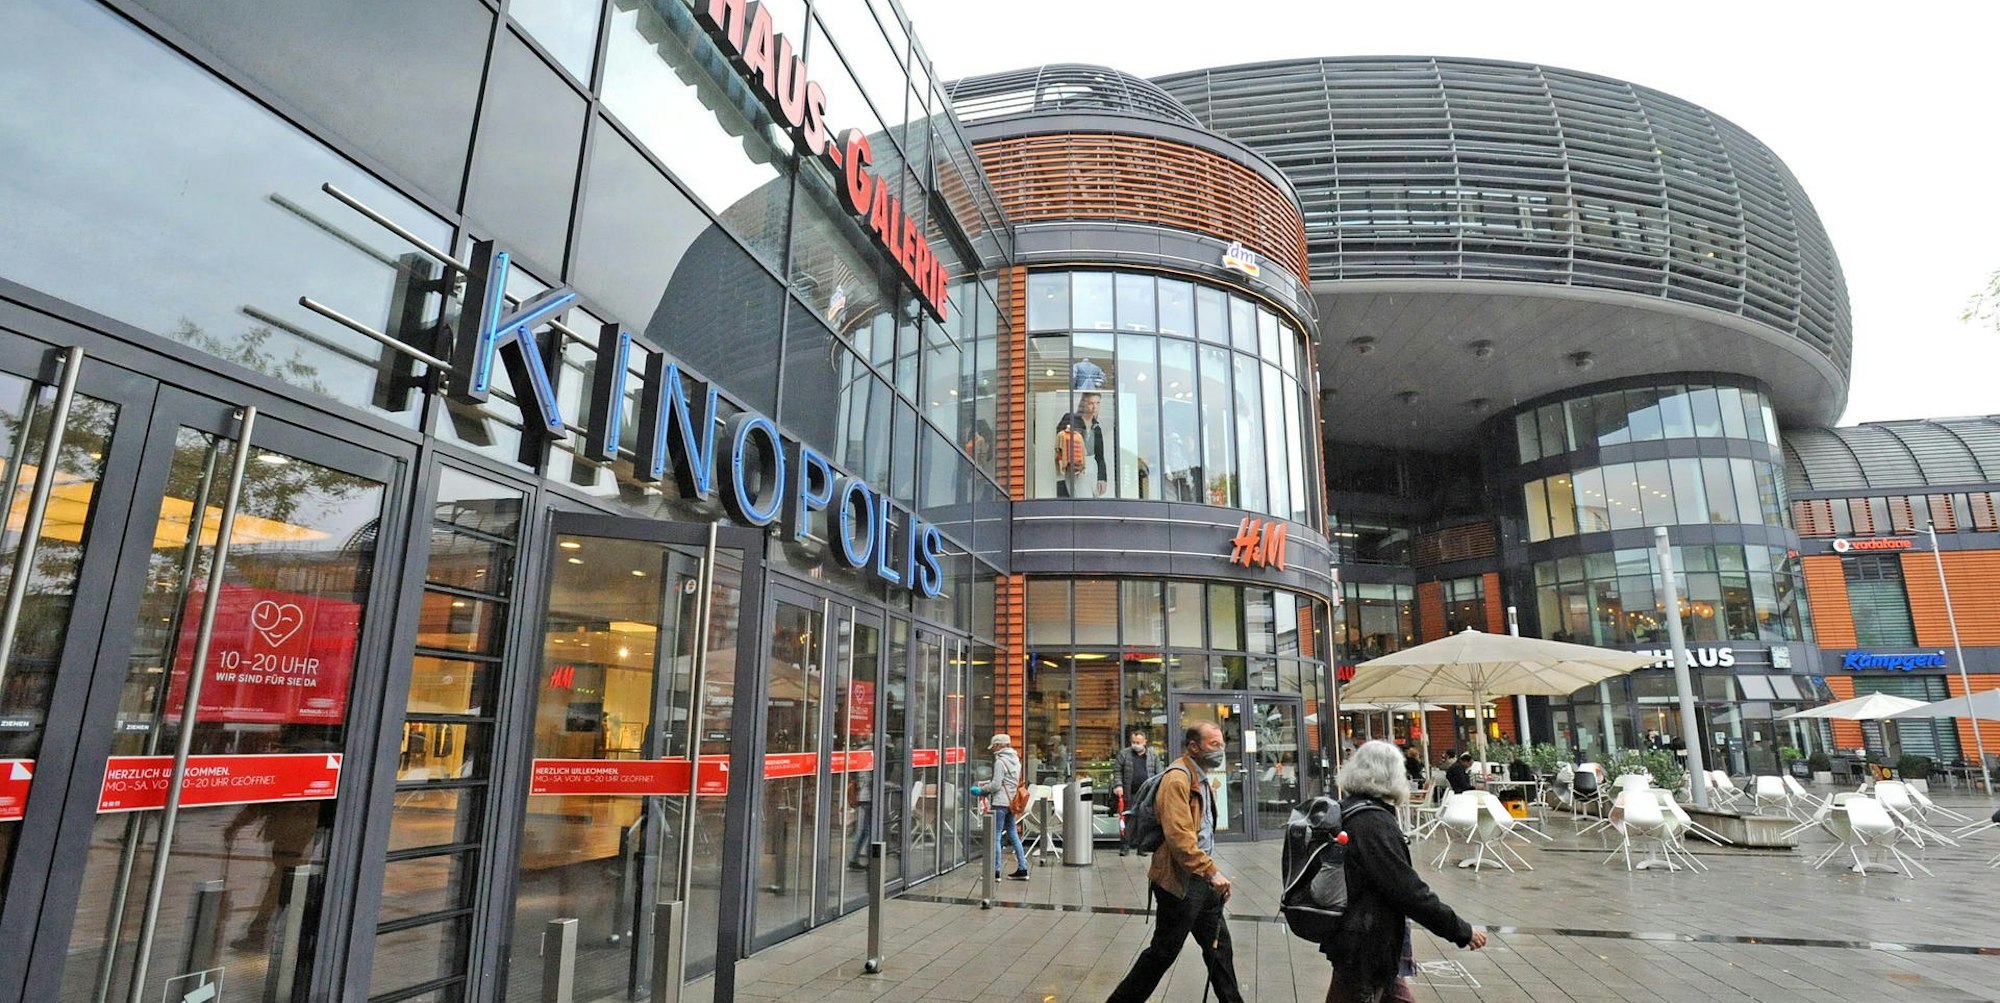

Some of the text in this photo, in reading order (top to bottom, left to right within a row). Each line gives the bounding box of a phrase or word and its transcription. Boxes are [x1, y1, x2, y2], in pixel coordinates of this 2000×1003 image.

[1230, 243, 1254, 265] dm
[455, 240, 944, 600] KINOPOLIS
[1230, 516, 1288, 571] H&M
[1851, 537, 1913, 550] vodafone
[281, 655, 320, 676] UHR
[215, 672, 317, 688] WIR SIND FÜR SIE DA
[0, 720, 30, 728] ZIEHEN
[107, 766, 230, 781] HERZLICH WKOMMEN.
[210, 776, 229, 788] UHR
[230, 775, 276, 786] GEÖFFNET.
